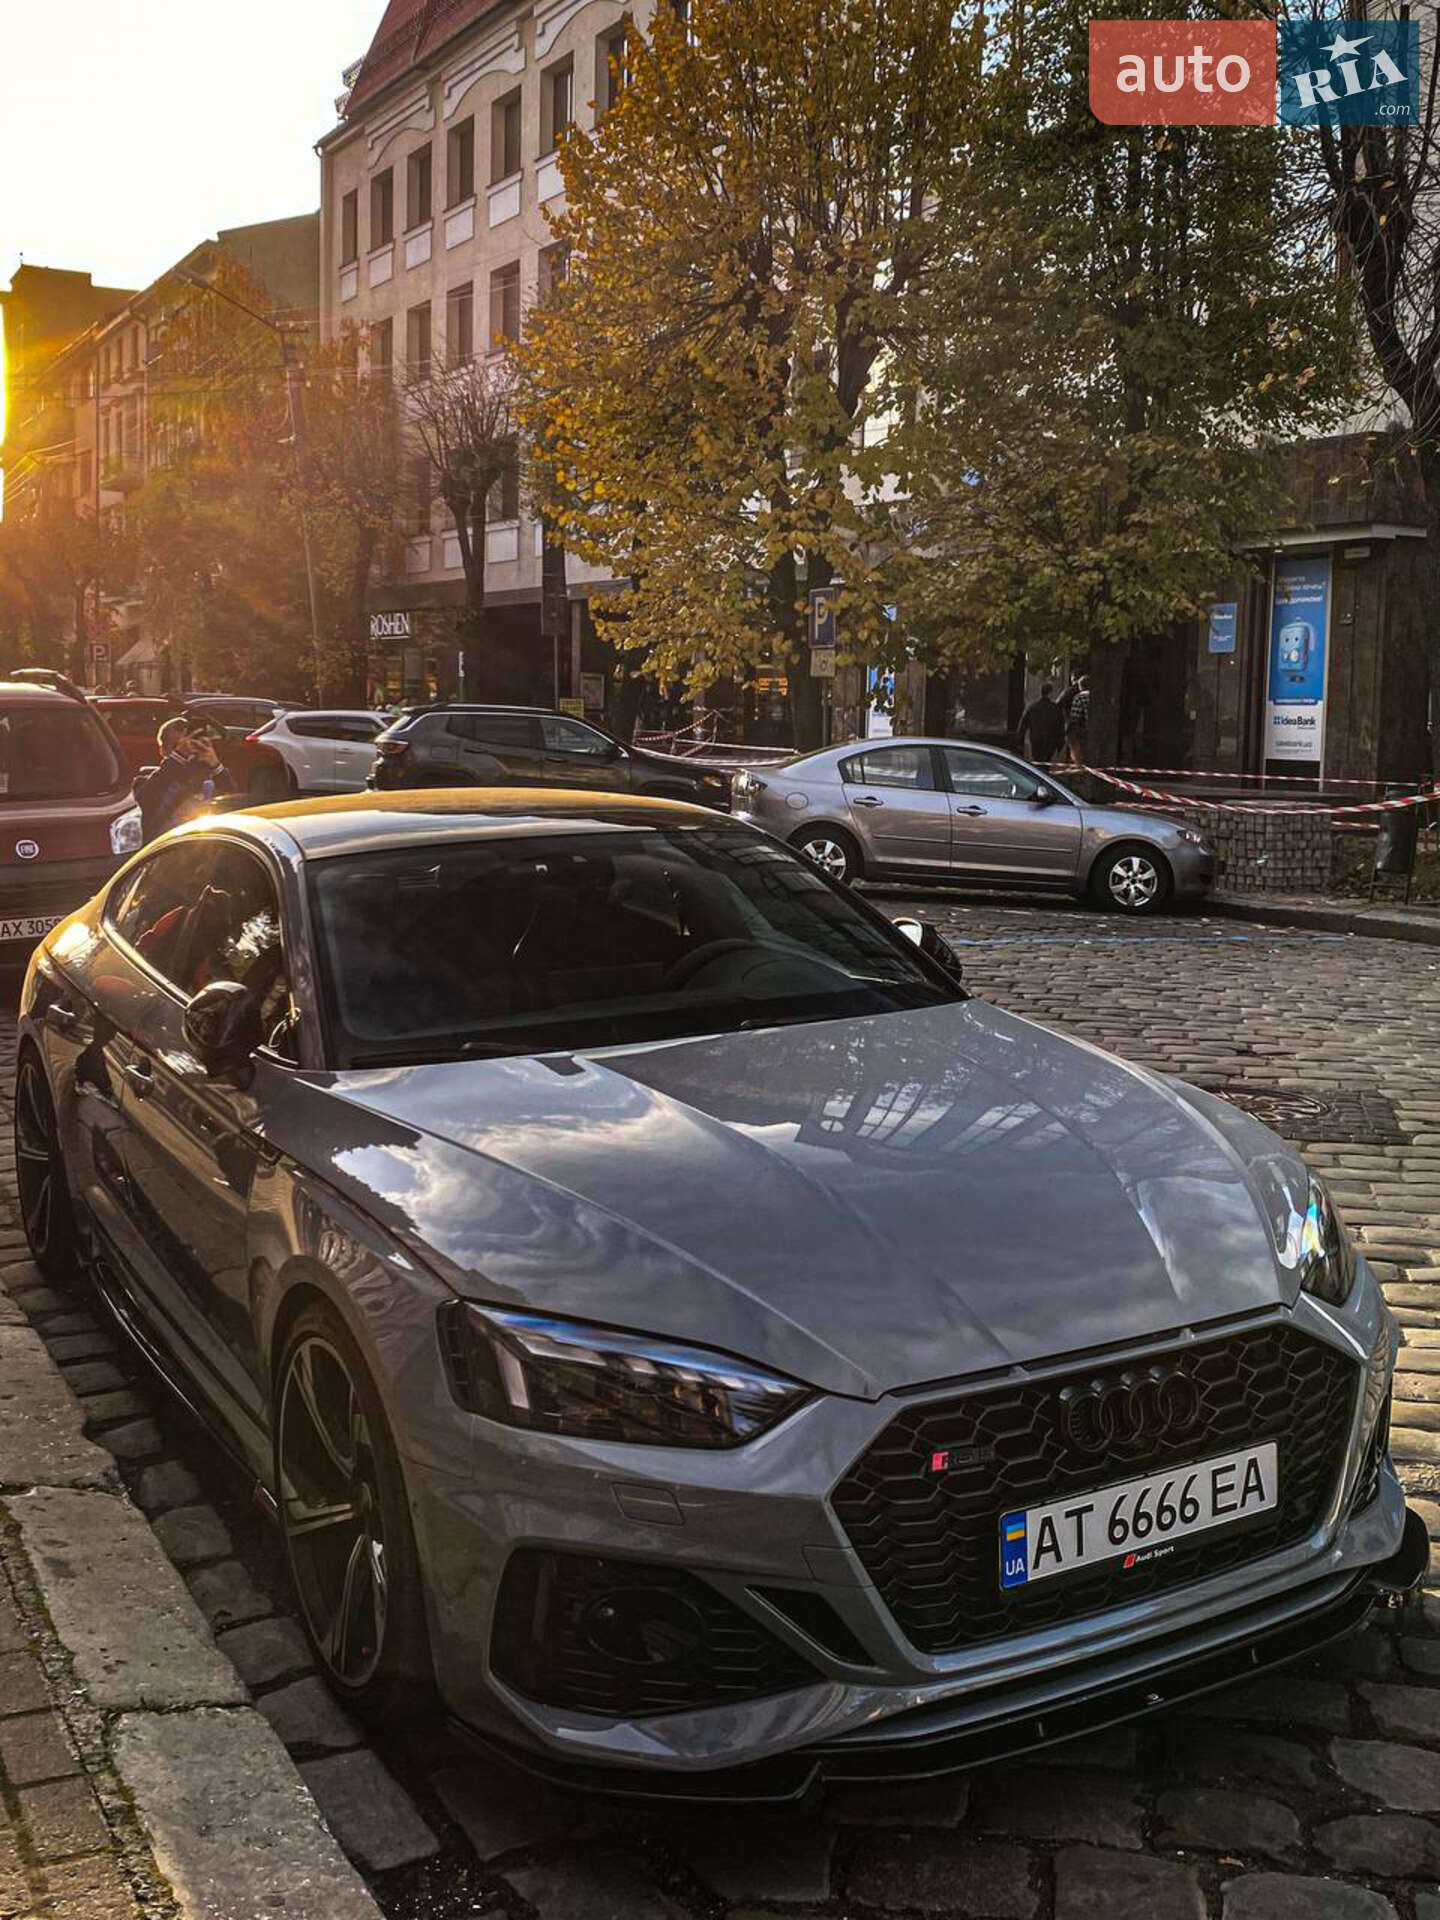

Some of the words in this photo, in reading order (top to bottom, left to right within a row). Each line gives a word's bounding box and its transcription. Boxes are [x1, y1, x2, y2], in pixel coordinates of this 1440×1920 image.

[370, 612, 409, 636] ROSHEN
[1, 921, 23, 937] AX
[1032, 1504, 1094, 1570] AT
[1107, 1474, 1200, 1545] 6666
[1211, 1457, 1265, 1517] EA
[1135, 1551, 1152, 1562] Audi
[1153, 1545, 1175, 1558] Sport
[1005, 1557, 1025, 1576] UA
